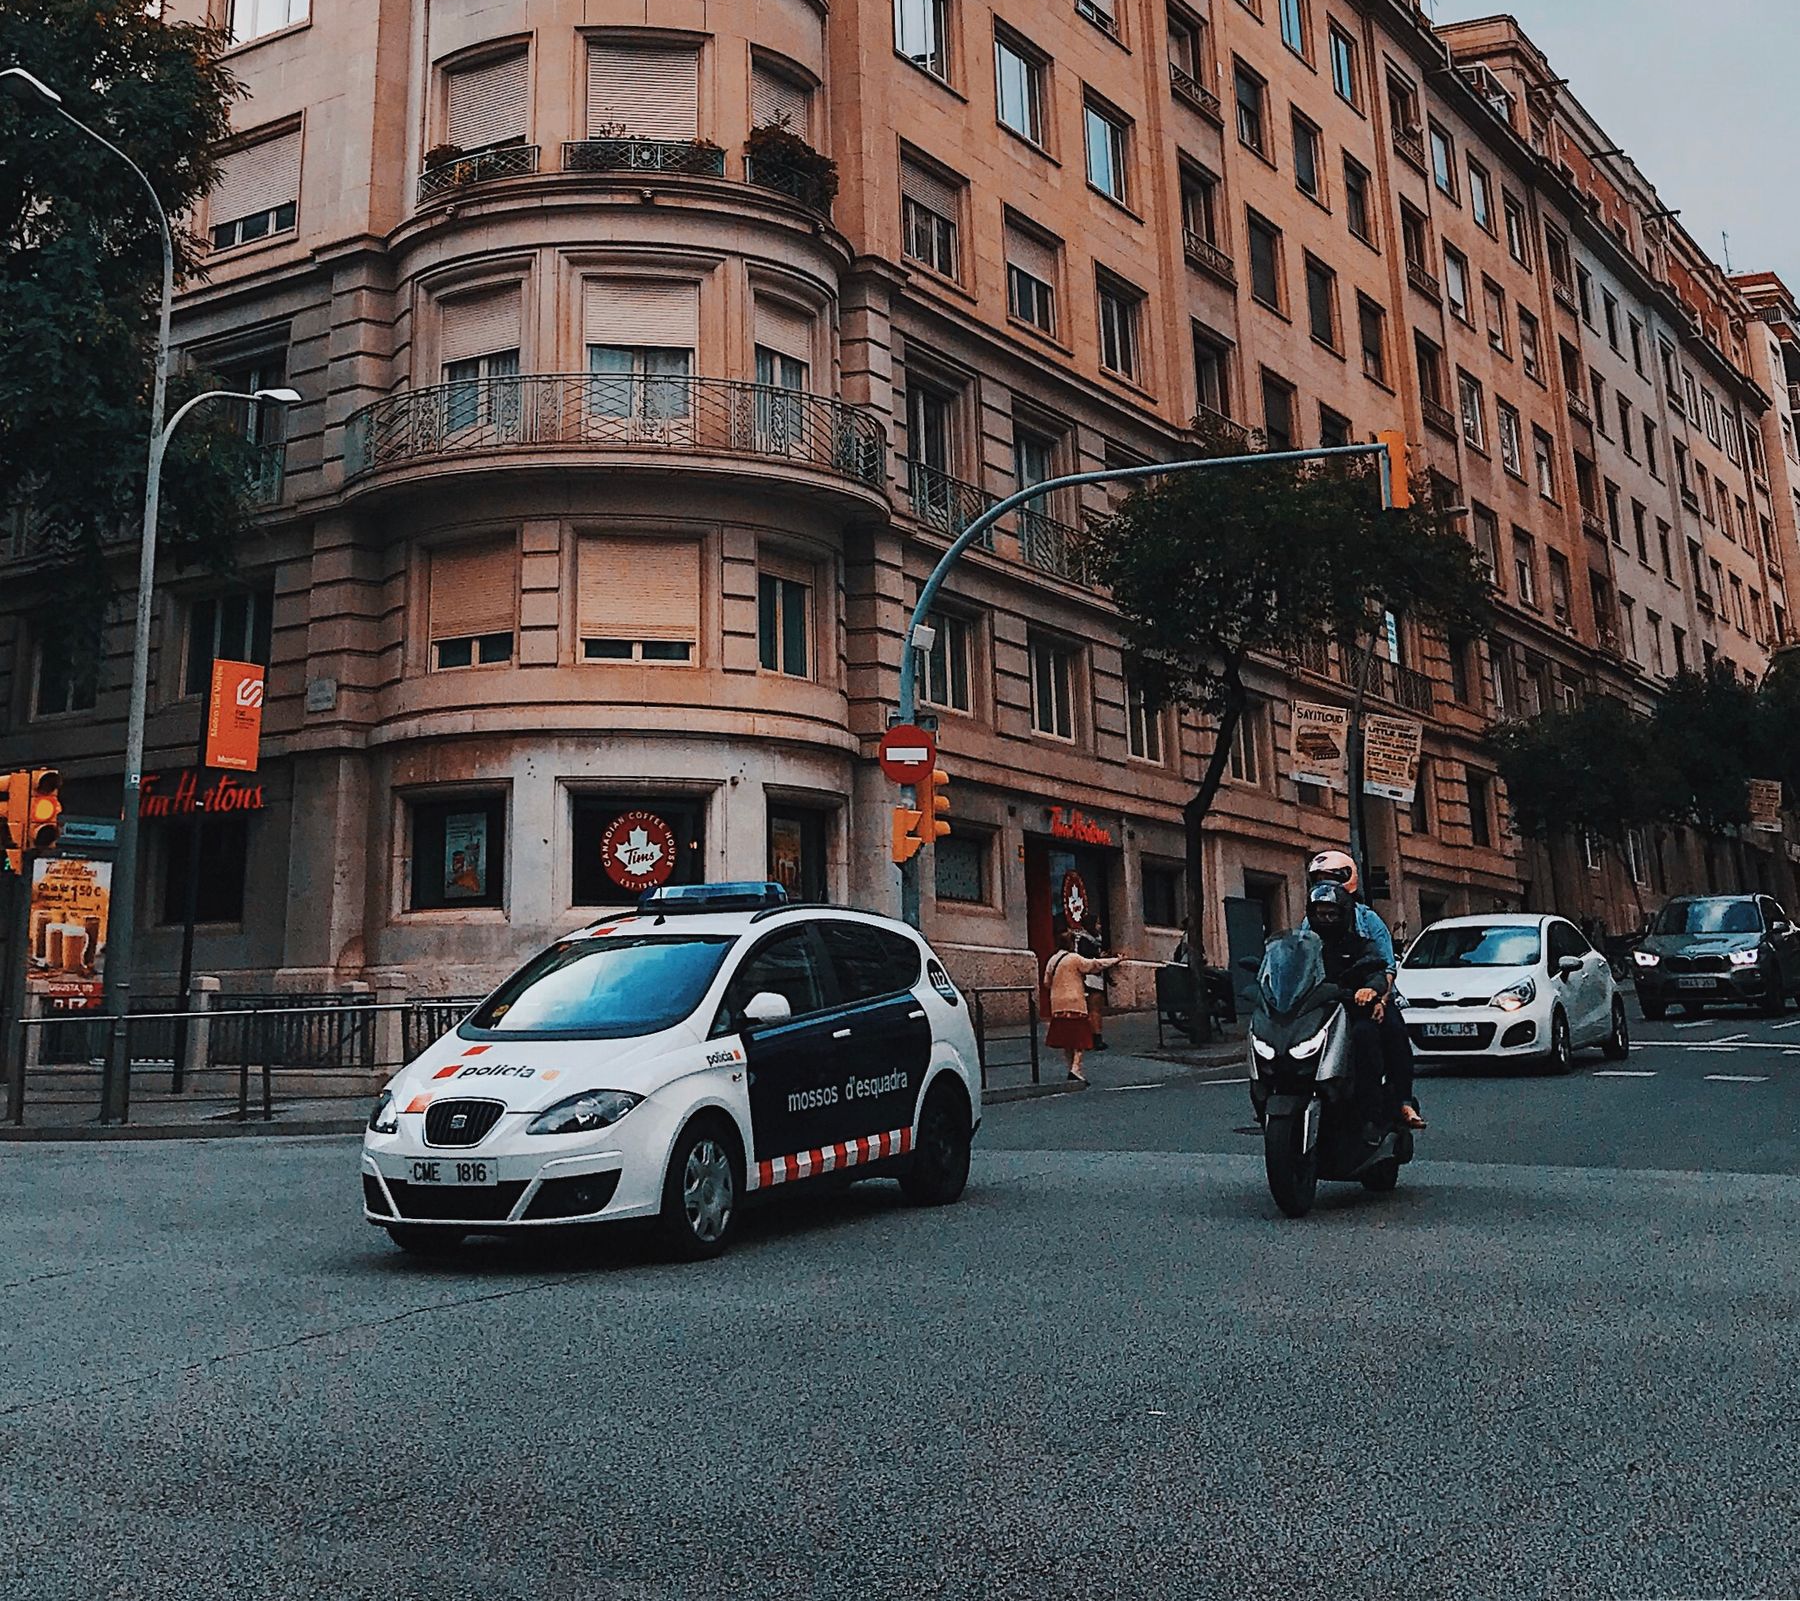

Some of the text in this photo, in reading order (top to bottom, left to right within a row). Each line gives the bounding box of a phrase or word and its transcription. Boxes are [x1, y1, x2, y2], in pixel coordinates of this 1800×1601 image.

[1368, 726, 1396, 737] LITTLE
[172, 769, 264, 816] Hrtons
[602, 811, 676, 868] CANADIAN COFFEE HOUSE
[624, 847, 655, 866] Tims
[930, 971, 950, 989] 112
[706, 1051, 734, 1067] policia
[457, 1064, 535, 1079] policia
[788, 1067, 908, 1112] mossos d'esquadra
[413, 1162, 487, 1182] CME 1816
